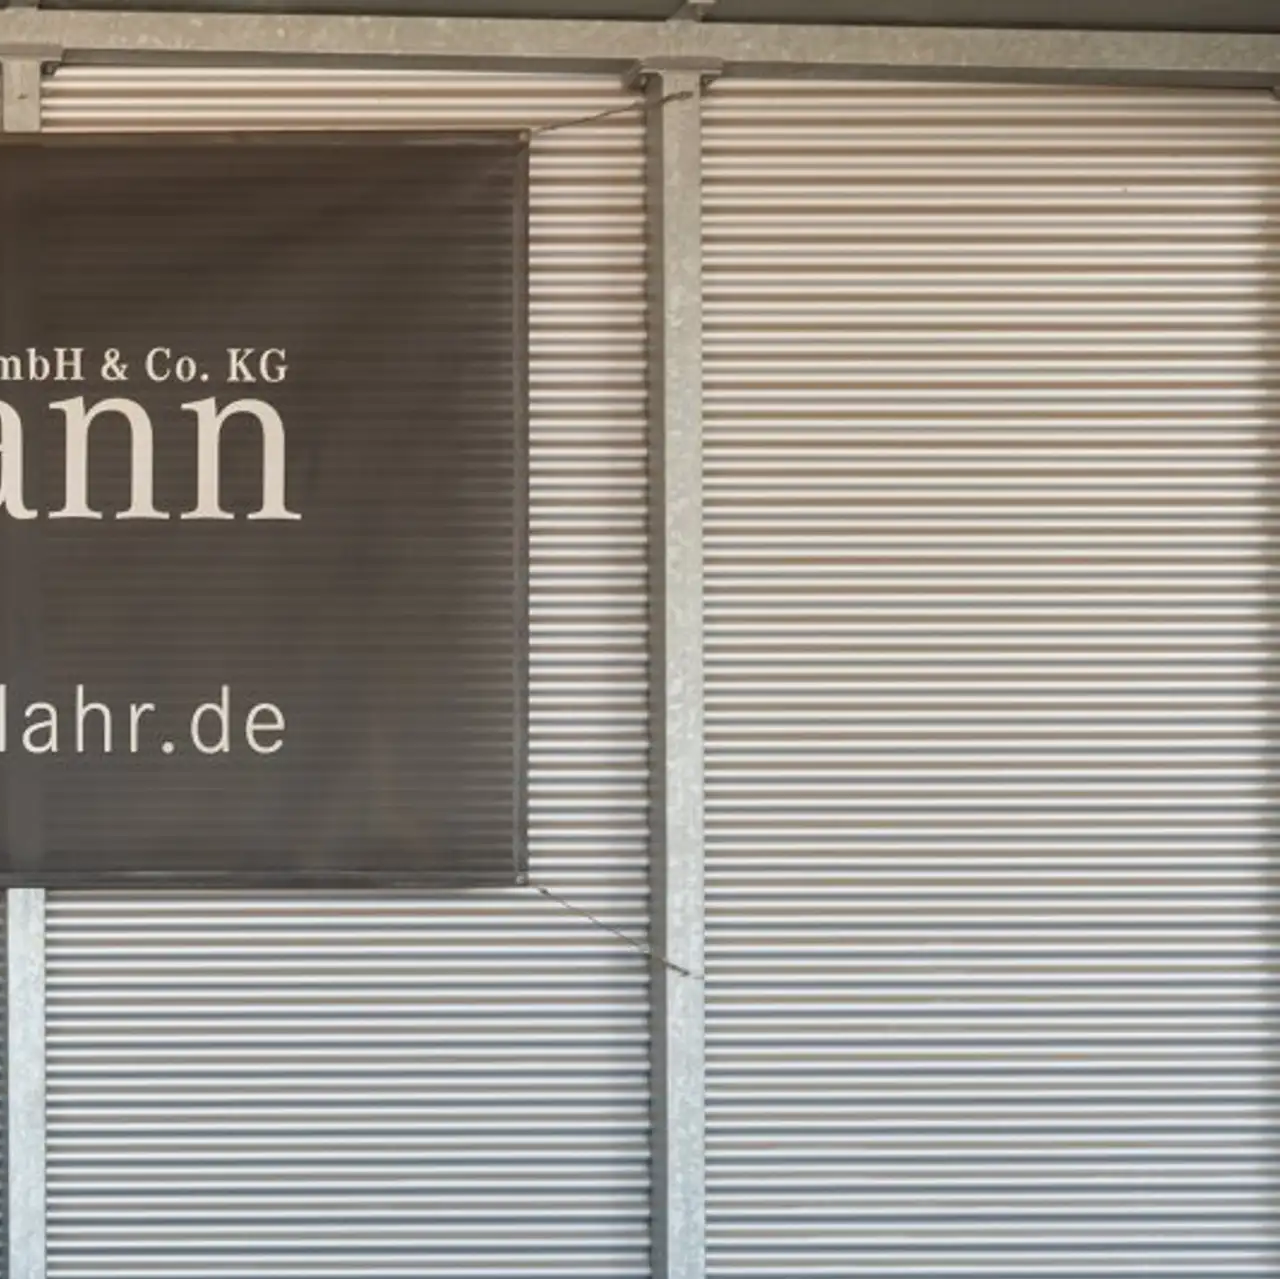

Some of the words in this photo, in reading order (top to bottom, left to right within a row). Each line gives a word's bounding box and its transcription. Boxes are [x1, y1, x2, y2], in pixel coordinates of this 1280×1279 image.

[101, 347, 129, 382] &
[145, 347, 210, 383] Co.
[226, 347, 288, 384] KG
